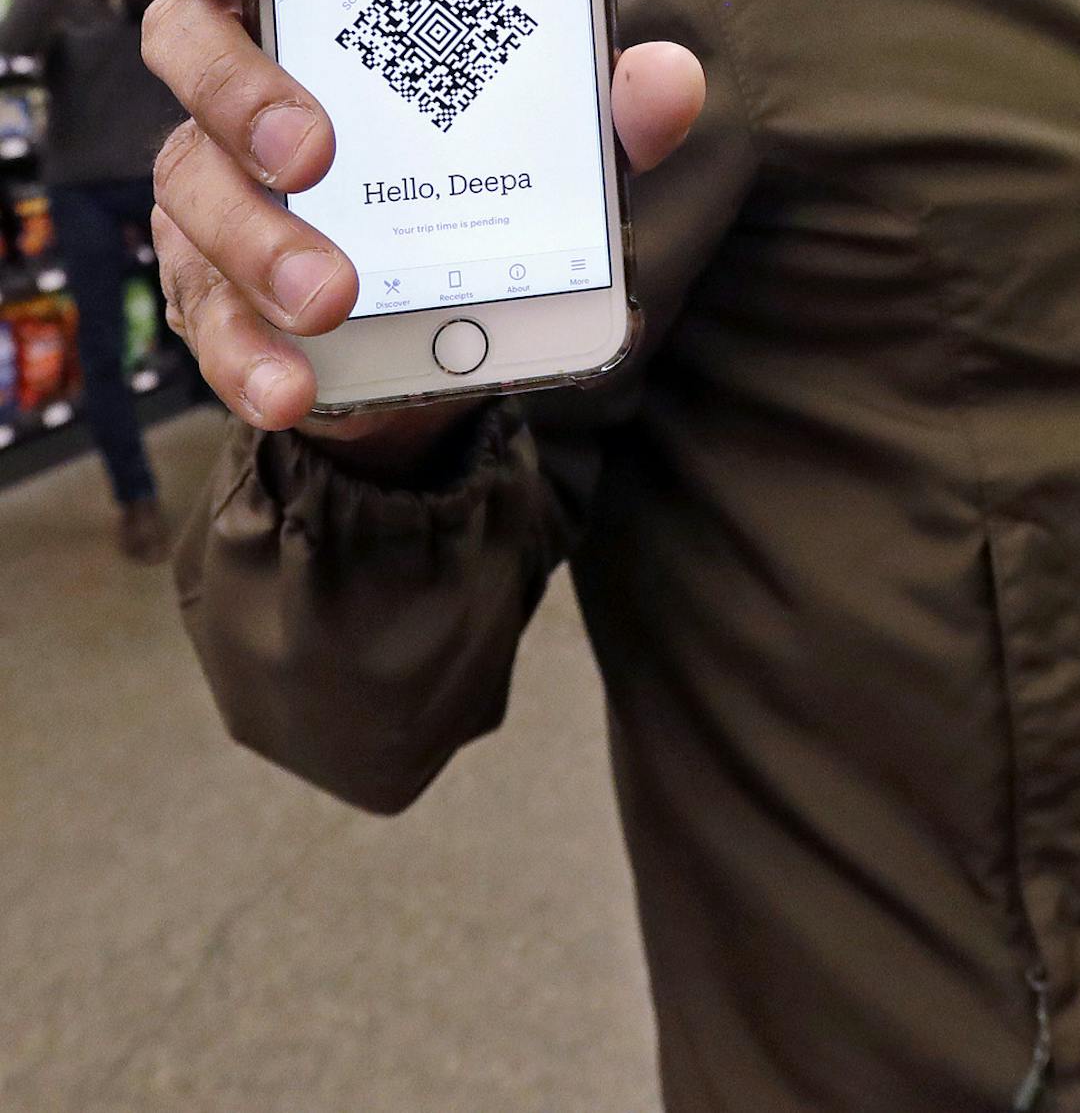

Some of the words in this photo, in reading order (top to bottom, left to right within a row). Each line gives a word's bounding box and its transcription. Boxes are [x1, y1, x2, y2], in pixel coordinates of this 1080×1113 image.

[362, 177, 441, 204] Hello,
[448, 172, 532, 195] Deepa
[392, 227, 414, 236] Your
[417, 224, 434, 234] trip
[436, 222, 458, 231] time
[460, 220, 468, 229] is
[470, 216, 510, 229] pending
[507, 285, 530, 293] About
[439, 292, 474, 302] Receipts
[375, 300, 411, 309] Discover
